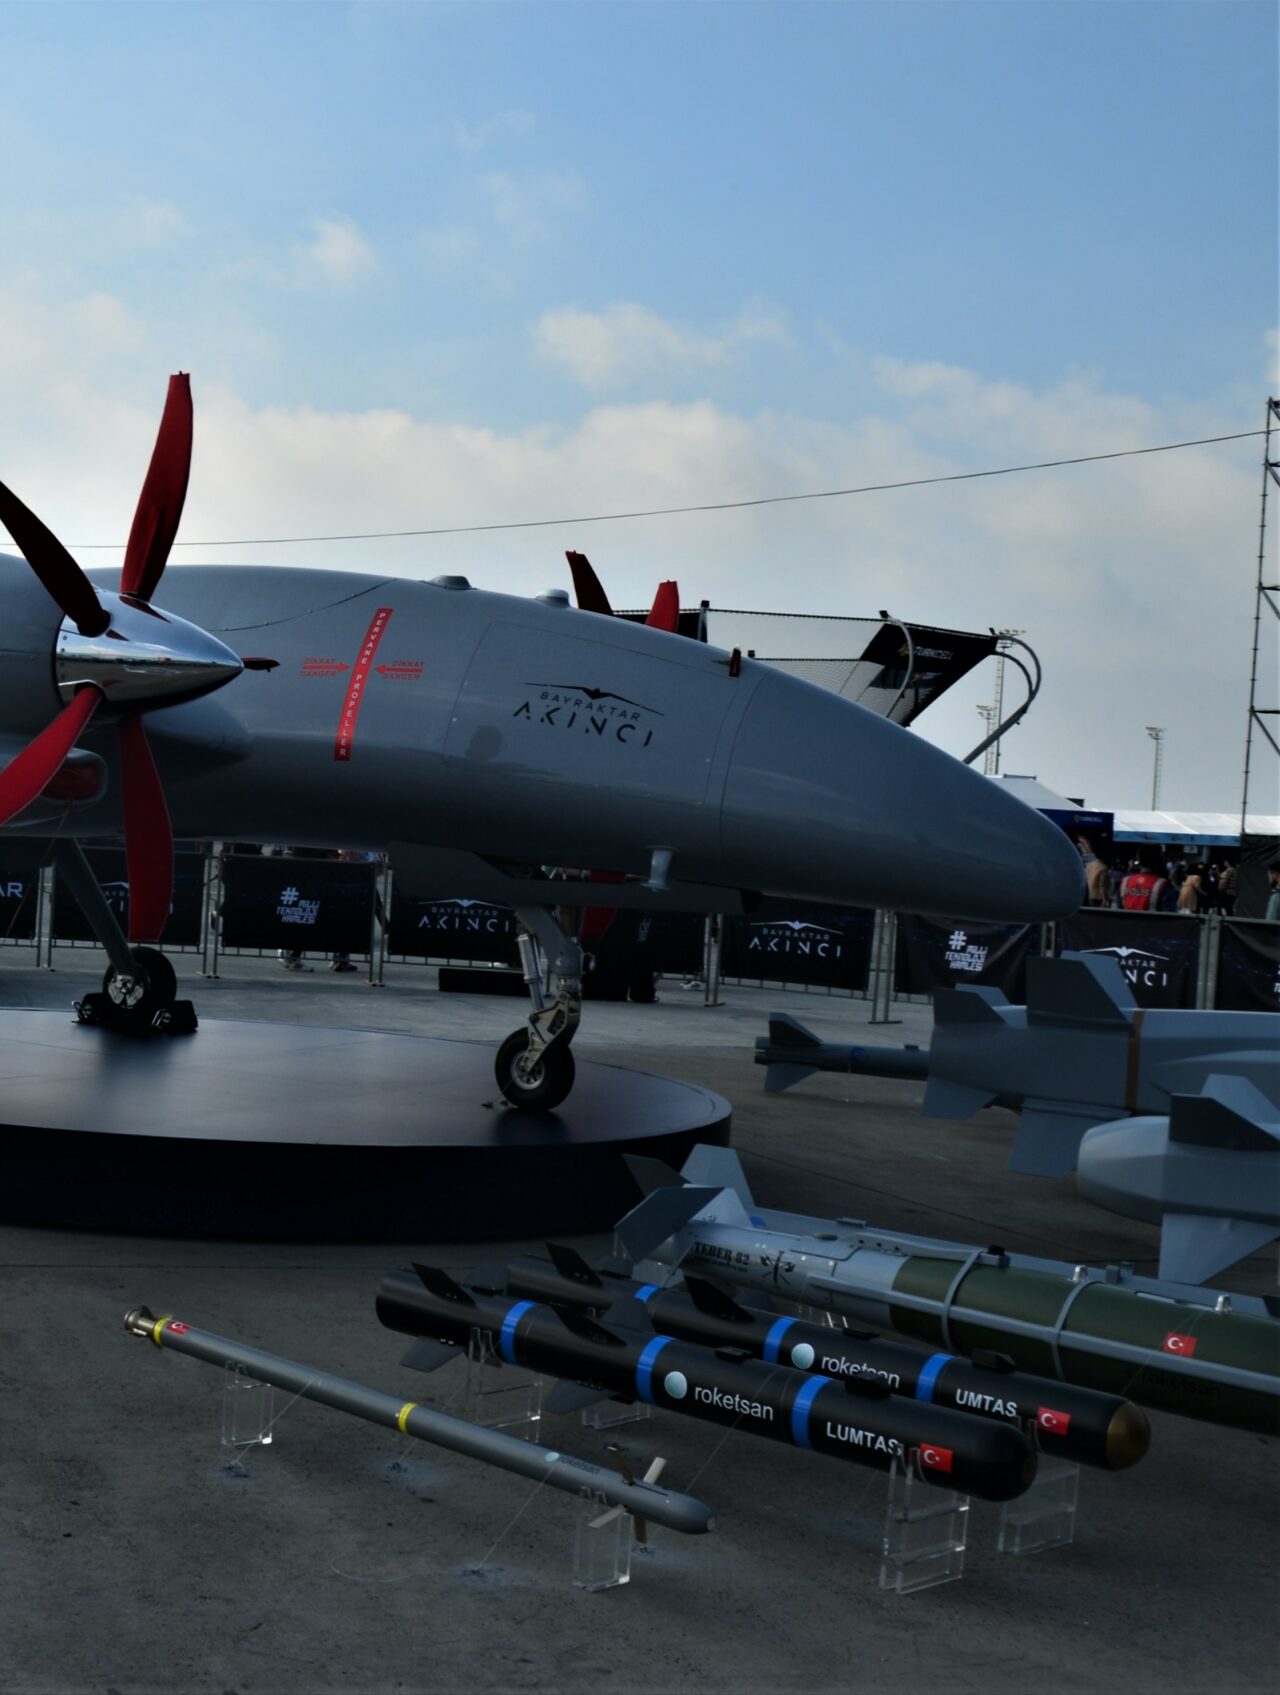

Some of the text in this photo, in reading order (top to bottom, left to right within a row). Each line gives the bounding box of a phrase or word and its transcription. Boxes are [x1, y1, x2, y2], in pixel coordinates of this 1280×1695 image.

[339, 612, 387, 756] PERVANE PROPELLER
[540, 691, 641, 722] BAYRAKTAR
[512, 701, 654, 748] AKINCI
[418, 914, 510, 933] AKINCI
[431, 906, 499, 917] BAYRAKTAR
[748, 936, 842, 958] AKINCI
[762, 927, 831, 941] BAYRAKTAR
[1119, 958, 1157, 968] AKTAR
[1124, 969, 1168, 987] NCI
[693, 1240, 733, 1262] TEBER
[735, 1251, 751, 1266] 82
[694, 1386, 774, 1422] roketsan
[955, 1387, 1018, 1418] UMTAS
[825, 1420, 903, 1456] LUMTAS
